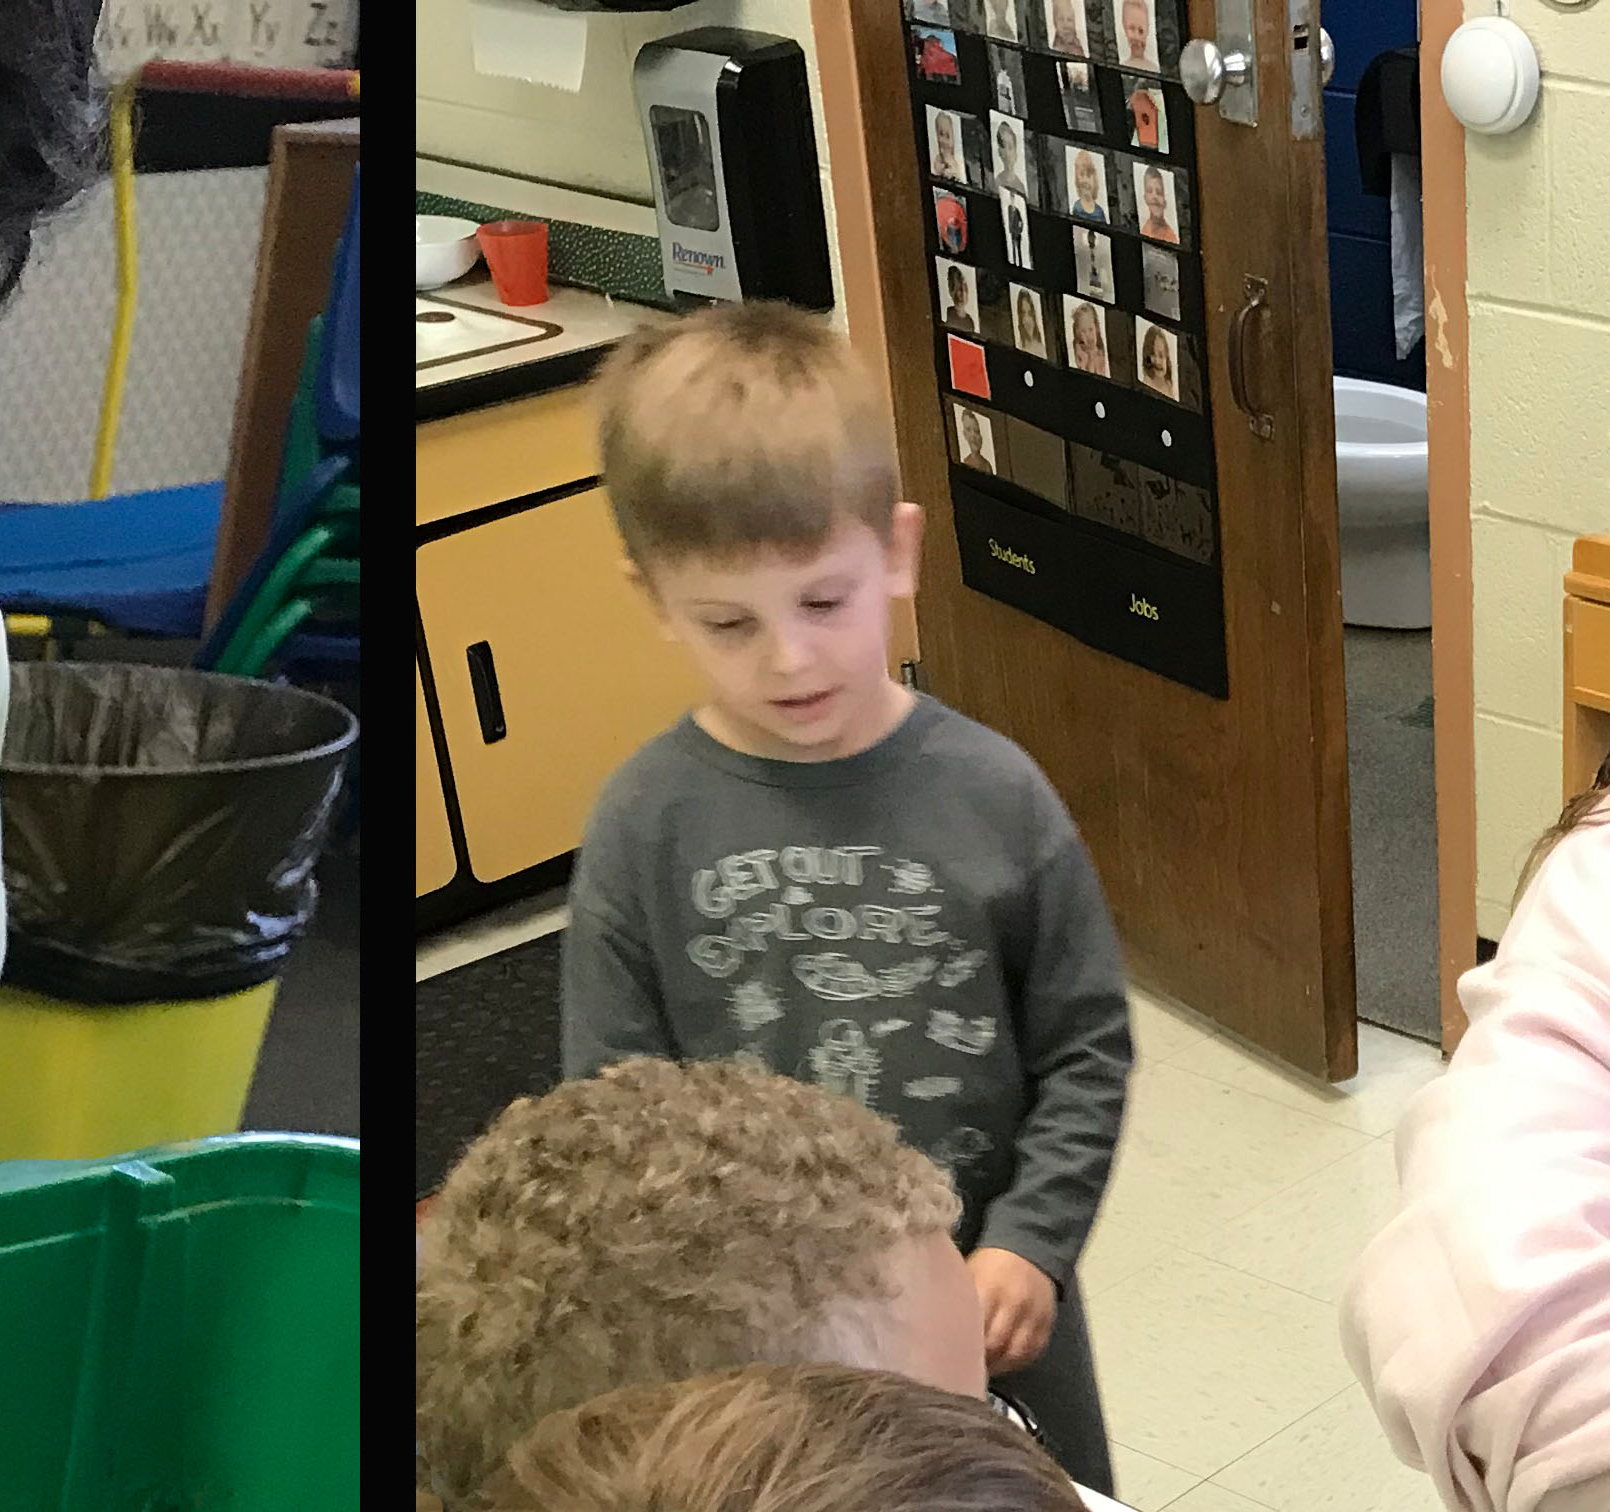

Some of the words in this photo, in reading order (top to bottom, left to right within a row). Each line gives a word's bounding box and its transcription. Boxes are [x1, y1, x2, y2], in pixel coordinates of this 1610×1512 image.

[672, 241, 725, 269] Renown
[988, 537, 1037, 575] Students
[1128, 592, 1160, 621] Jobs
[691, 849, 780, 919] GET
[779, 845, 884, 887] OUT
